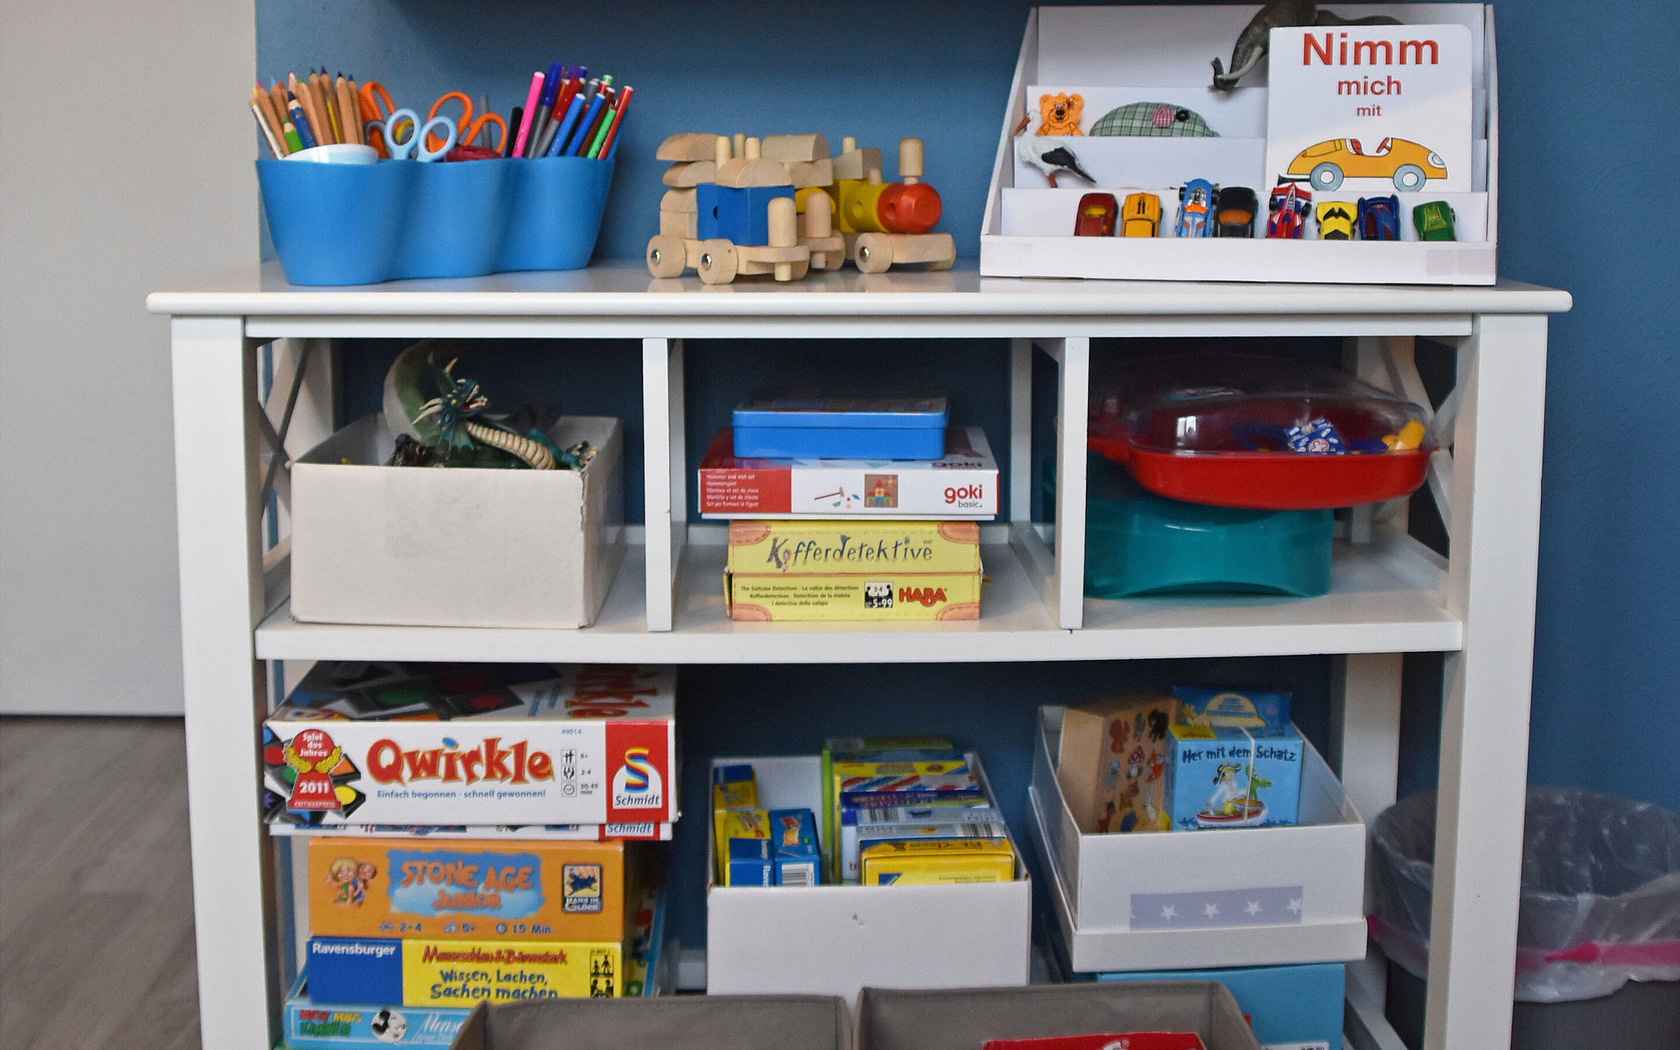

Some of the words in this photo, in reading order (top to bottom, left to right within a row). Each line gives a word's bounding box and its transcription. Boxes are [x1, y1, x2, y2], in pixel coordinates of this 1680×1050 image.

[1303, 32, 1439, 66] Nimm
[1337, 75, 1402, 96] mich
[1356, 104, 1382, 117] mit
[944, 484, 983, 504] goki
[873, 598, 893, 608] 5-99
[899, 586, 948, 608] HABA
[302, 732, 323, 742] Spiel
[307, 740, 323, 748] des
[300, 747, 329, 757] Jahres
[1182, 749, 1203, 764] Her
[1206, 746, 1225, 760] mit
[1229, 745, 1252, 758] dem
[1256, 745, 1297, 762] Schatz
[366, 736, 555, 787] Qwirkle
[299, 781, 330, 794] 2011
[377, 790, 409, 799] Einfach
[411, 790, 456, 800] begonnen
[464, 790, 494, 799] schnell
[496, 790, 546, 800] gewonnen!
[615, 795, 660, 806] Schmidt
[607, 823, 651, 833] Schmidt
[401, 859, 479, 888] STONE
[482, 865, 533, 893] AGE
[512, 923, 526, 934] 15
[312, 942, 396, 958] Ravensburger
[430, 983, 491, 999] Sachen
[495, 986, 558, 999] machen
